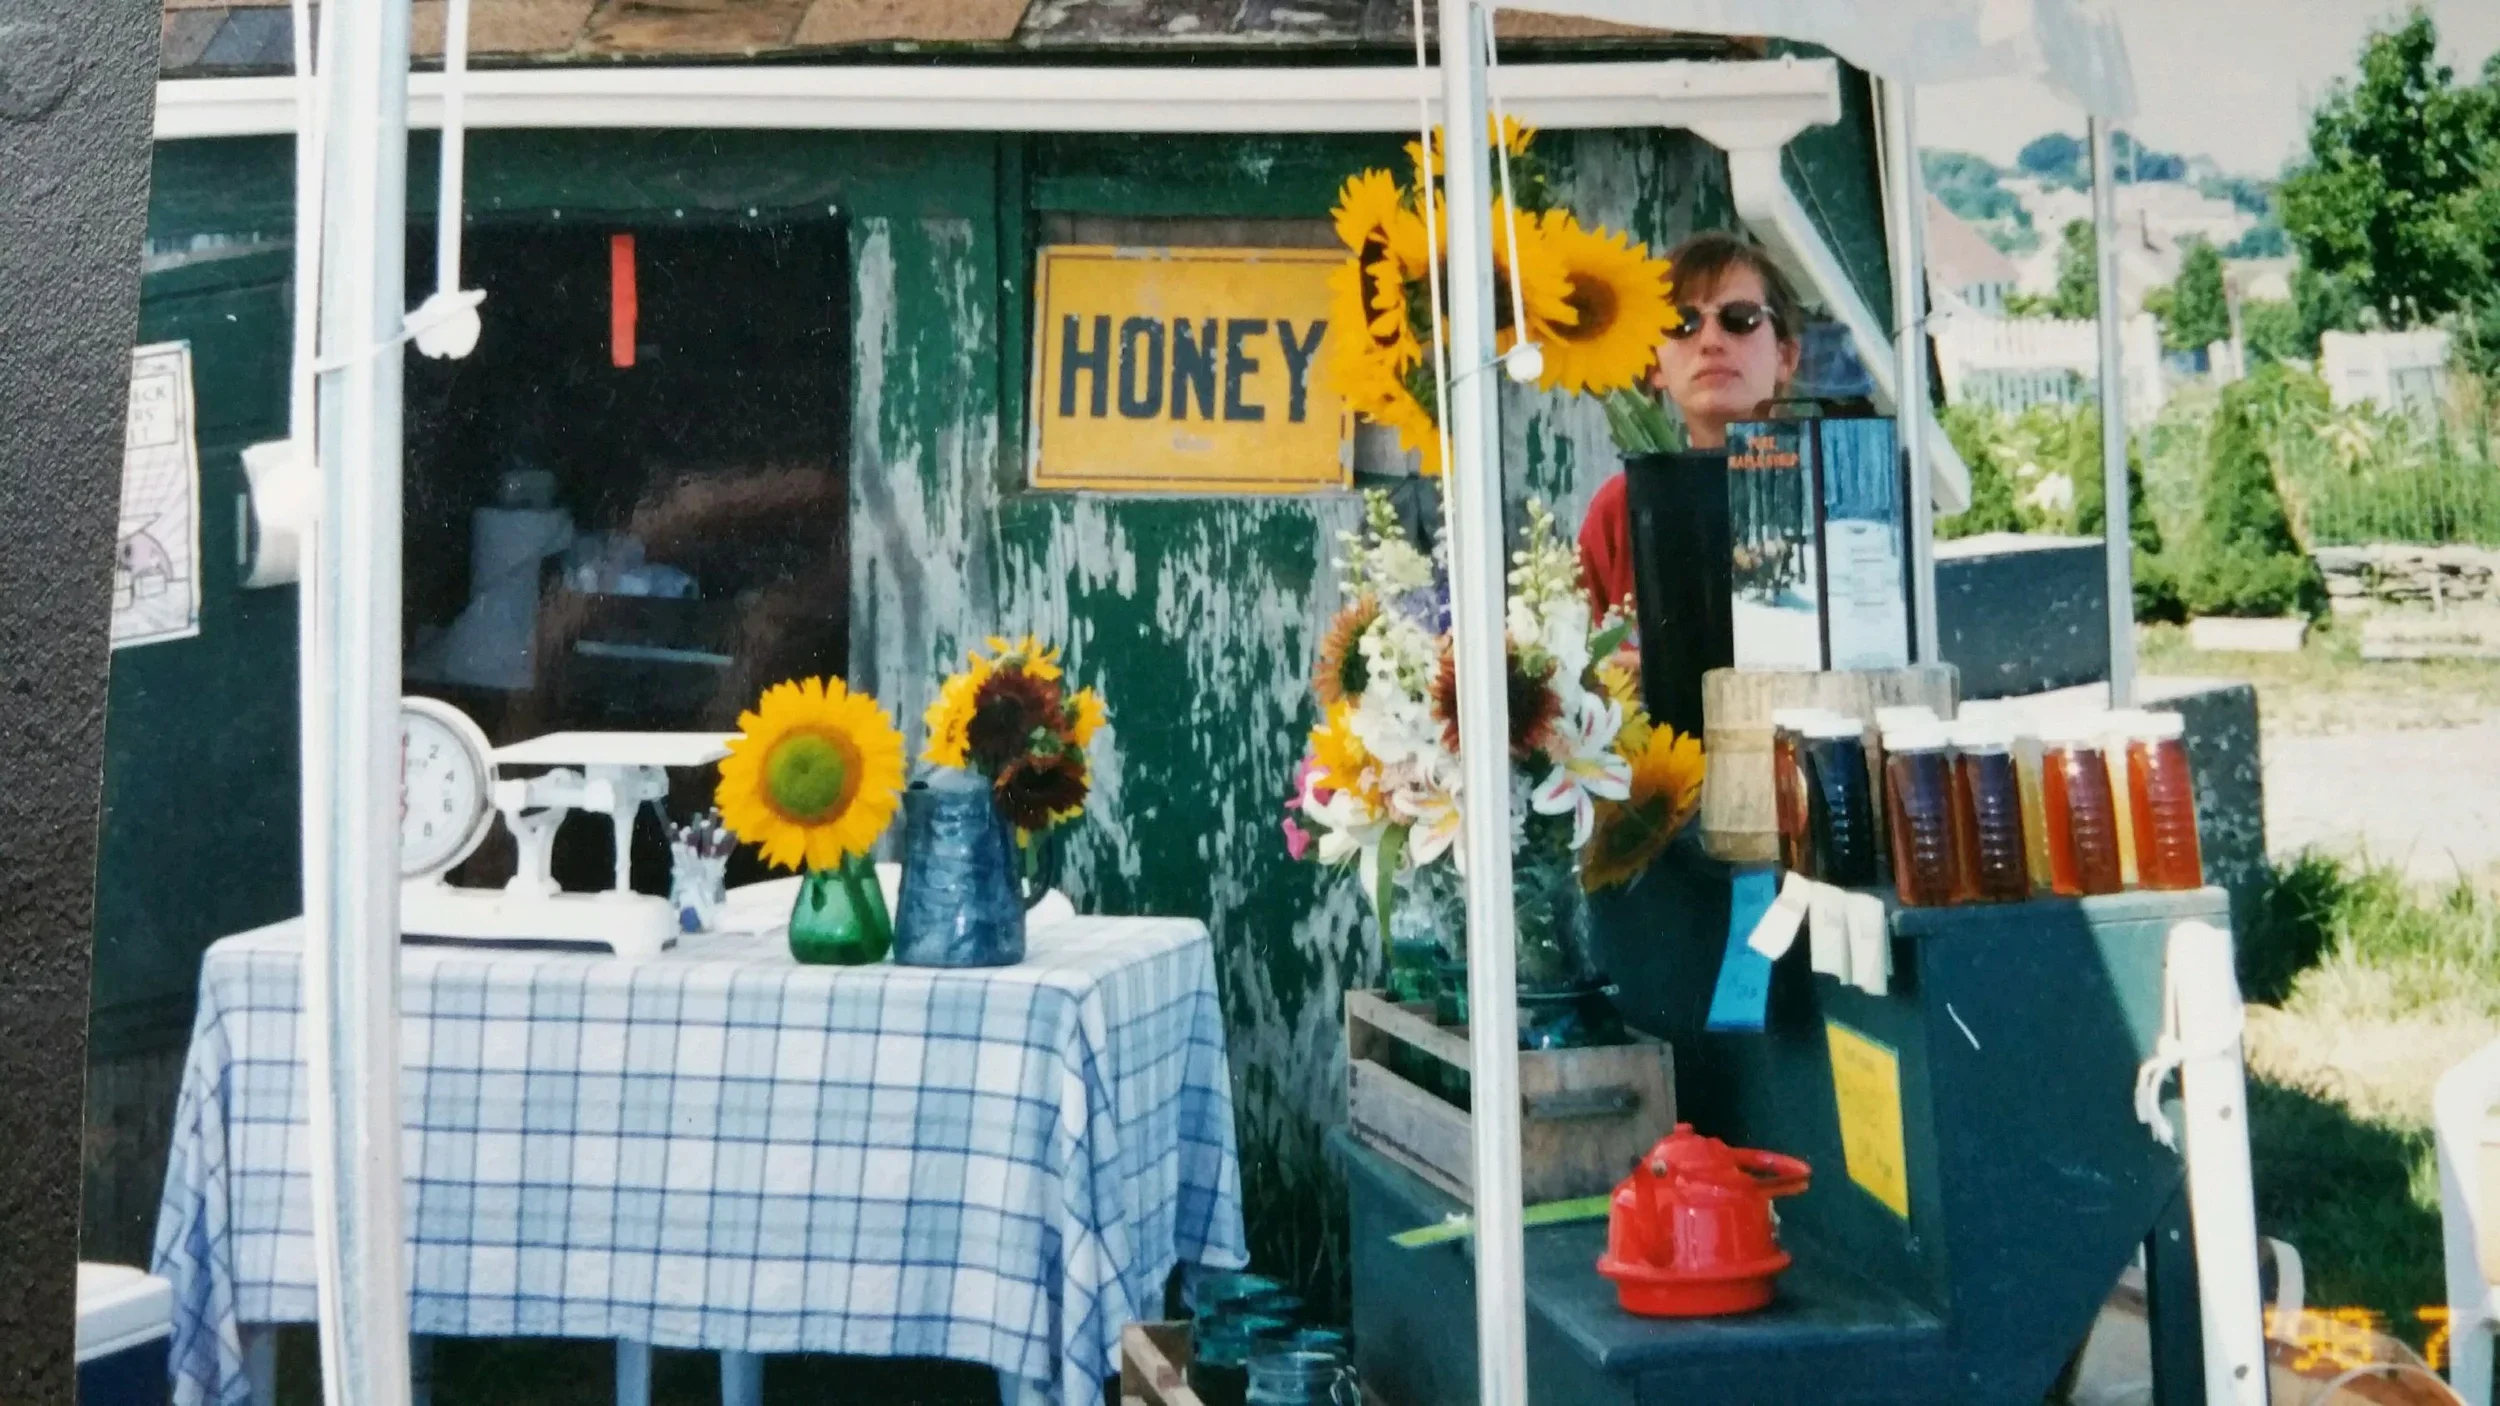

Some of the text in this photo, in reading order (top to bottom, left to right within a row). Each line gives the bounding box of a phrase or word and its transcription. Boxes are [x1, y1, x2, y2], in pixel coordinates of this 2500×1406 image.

[1058, 313, 1329, 422] HONEY
[429, 744, 440, 759] 2
[444, 769, 455, 783] 4
[443, 798, 453, 813] 6
